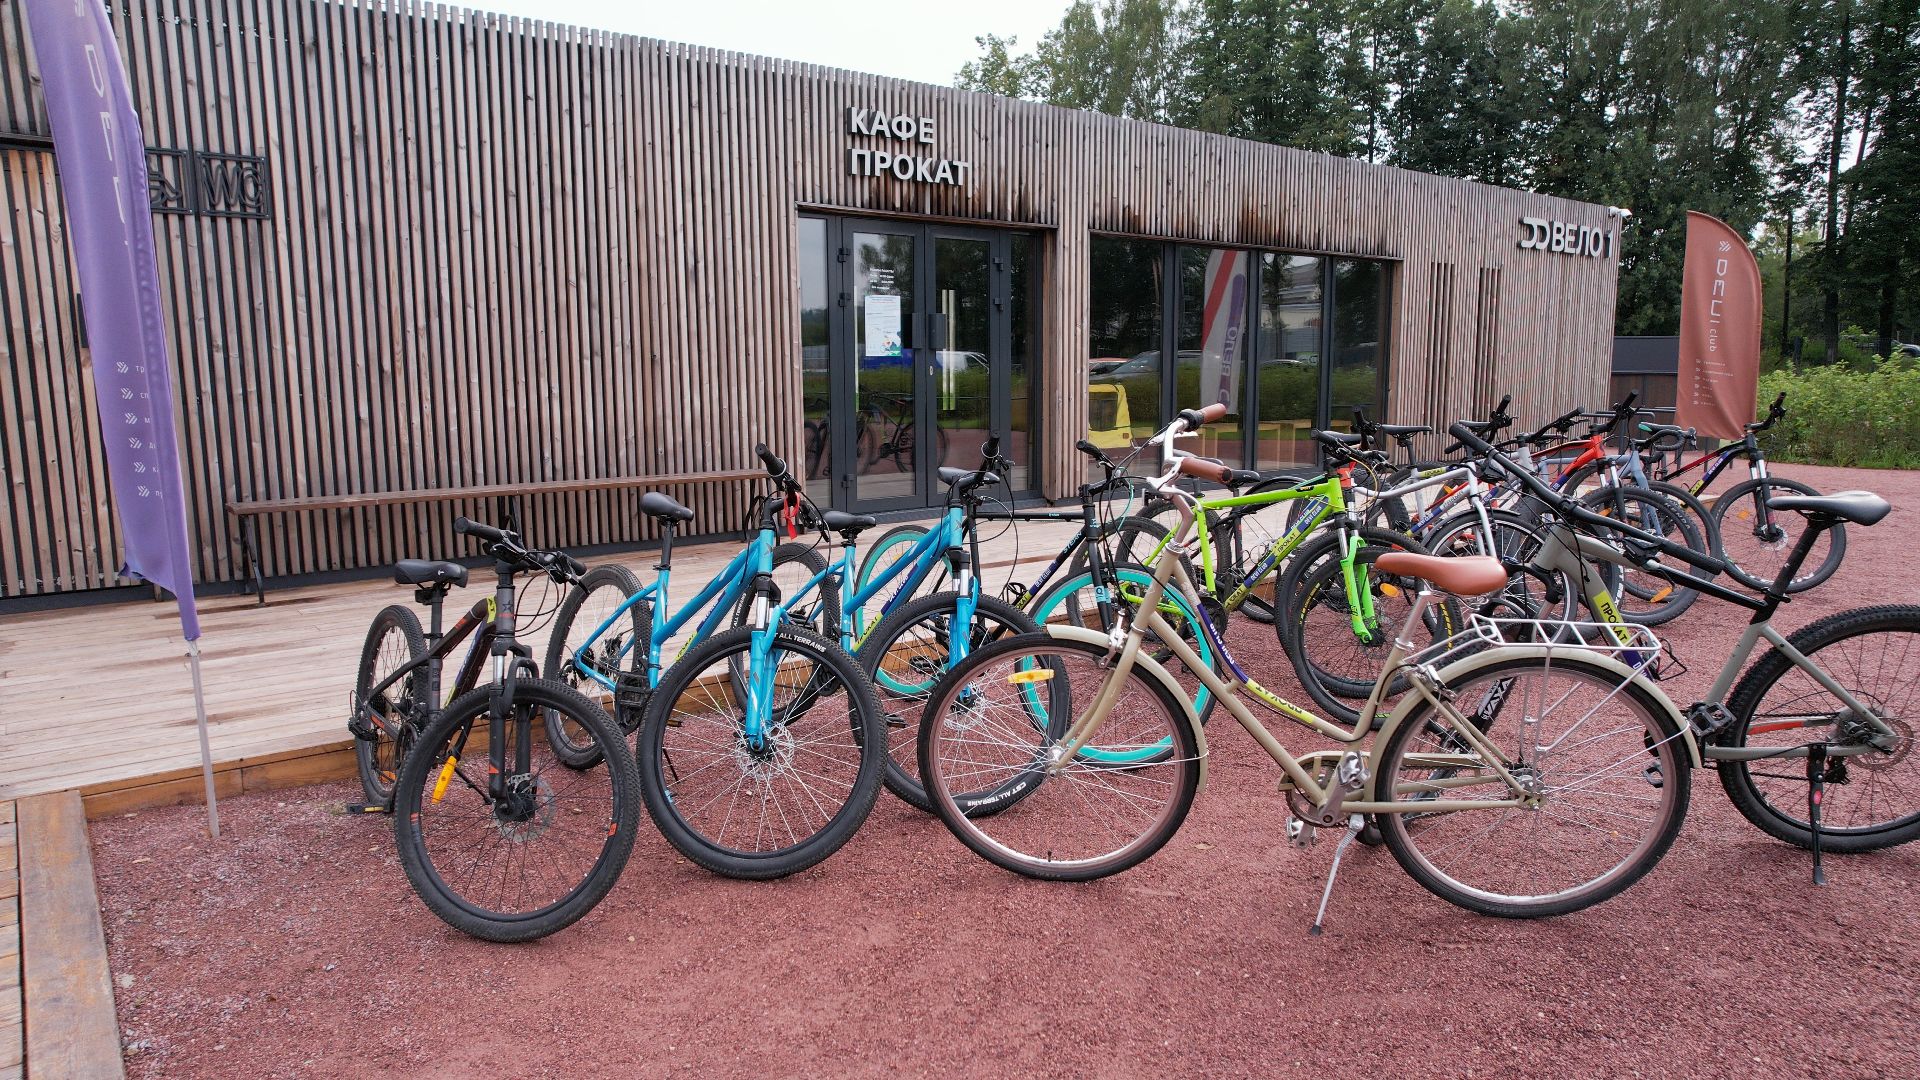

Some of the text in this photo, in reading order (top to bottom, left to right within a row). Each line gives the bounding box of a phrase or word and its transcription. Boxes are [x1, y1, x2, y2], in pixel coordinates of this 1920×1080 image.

[849, 106, 935, 144] КАФЕ
[200, 160, 264, 208] WC
[849, 148, 969, 186] ПРОКАТ
[1551, 221, 1603, 257] ВЕЛО
[1709, 328, 1718, 352] club
[1277, 533, 1297, 552] ПРОКАТ
[1601, 602, 1628, 642] ПРОАТ
[778, 632, 793, 640] ALL
[793, 634, 827, 653] TERRAINS
[967, 781, 1027, 807] CST ALL TERRAINS
